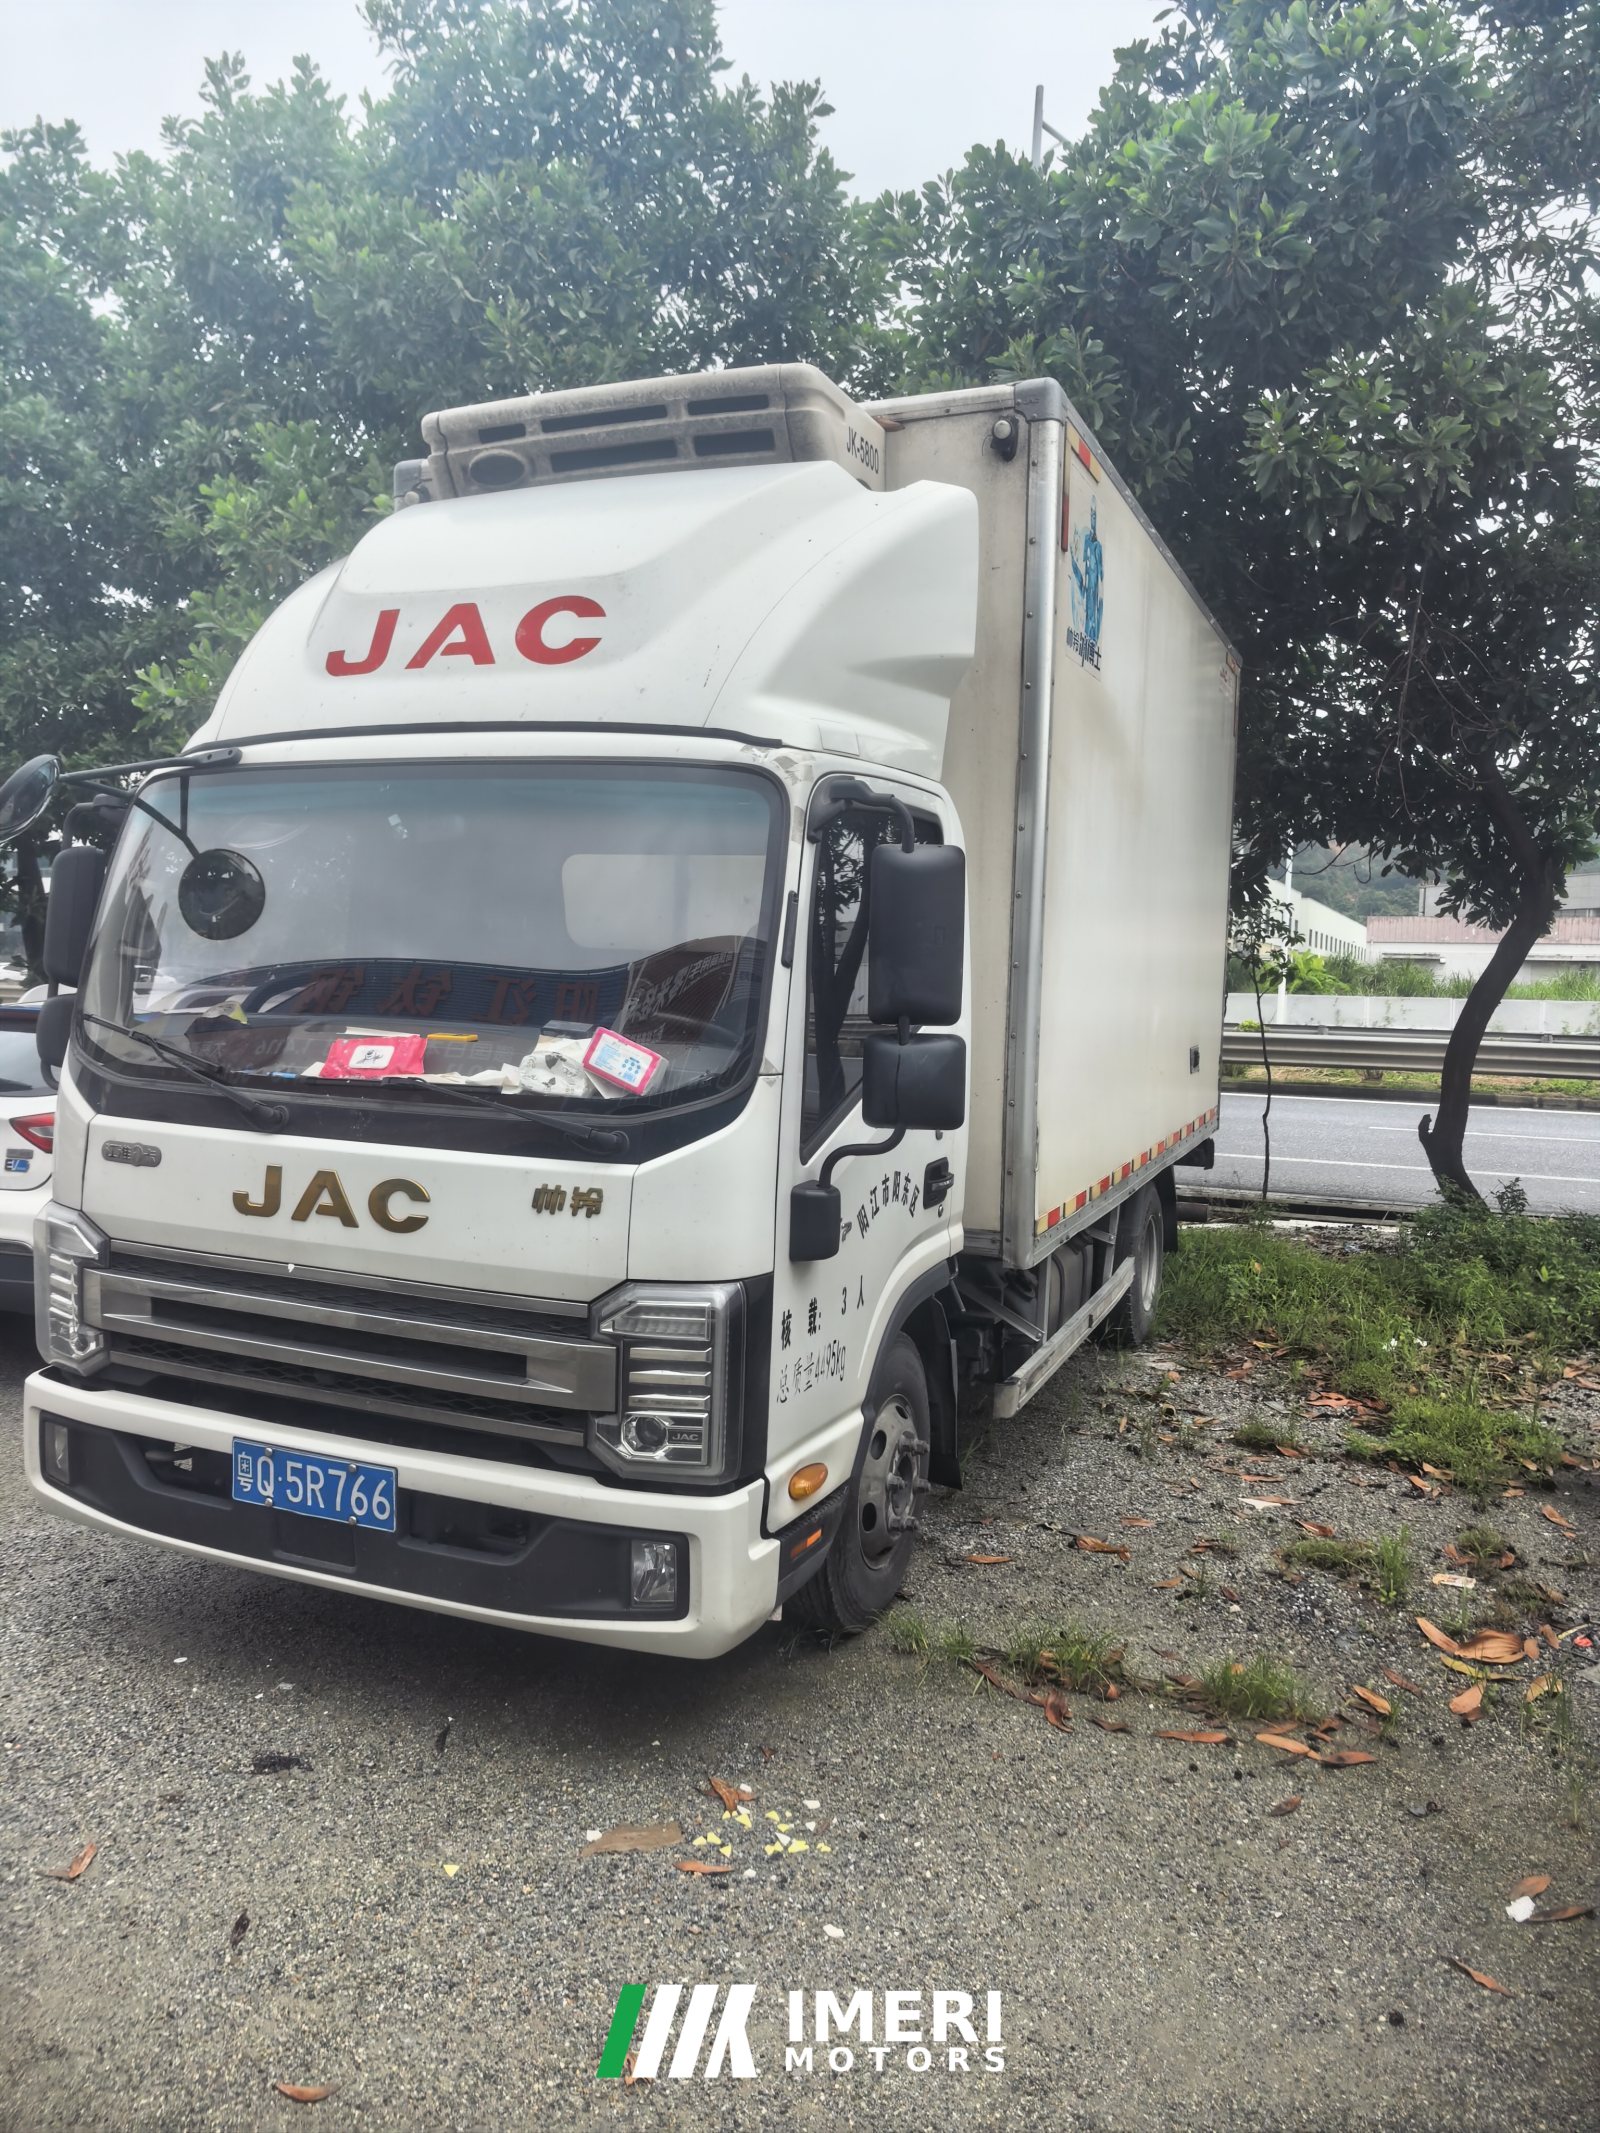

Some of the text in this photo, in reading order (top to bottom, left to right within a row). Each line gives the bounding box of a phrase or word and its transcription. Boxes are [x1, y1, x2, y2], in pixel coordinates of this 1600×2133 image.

[847, 426, 879, 475] JK-5800
[325, 595, 607, 677] JAC
[232, 1164, 430, 1233] JAC
[531, 1183, 604, 1218] 帅铃
[671, 1433, 699, 1441] JAC
